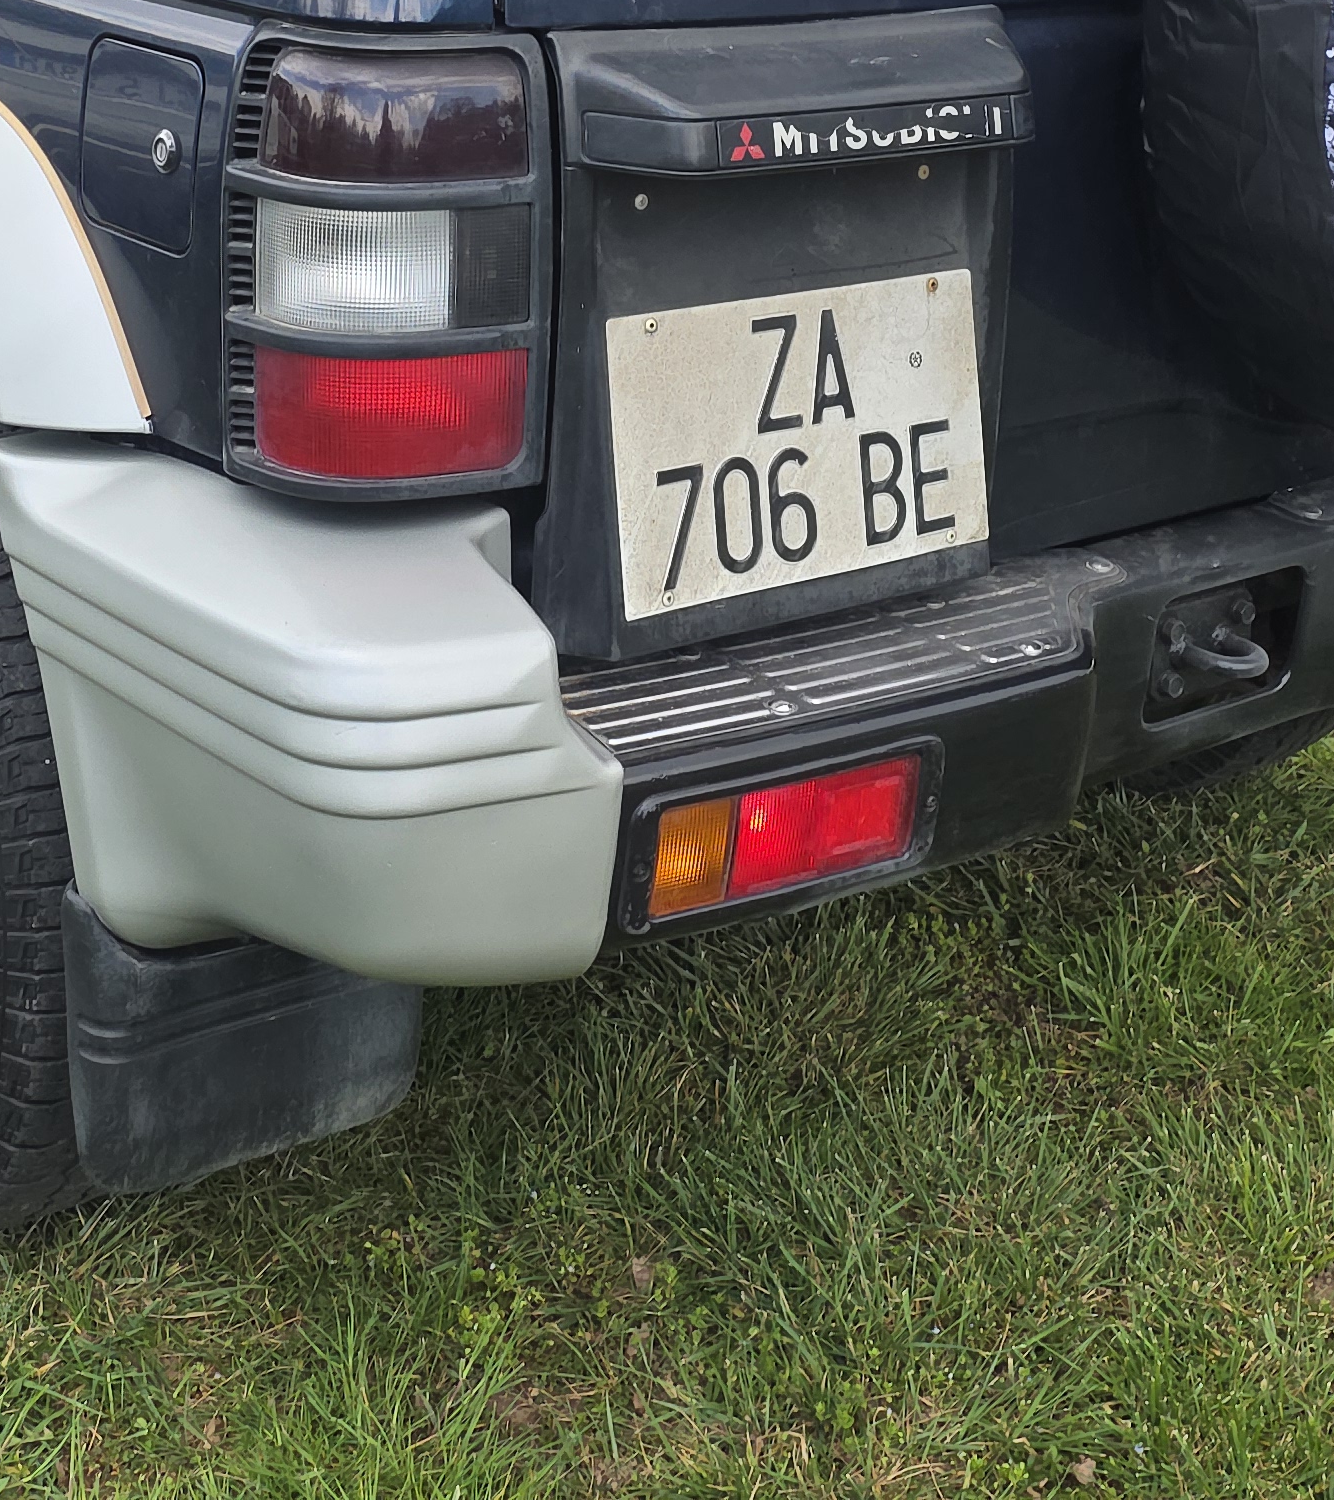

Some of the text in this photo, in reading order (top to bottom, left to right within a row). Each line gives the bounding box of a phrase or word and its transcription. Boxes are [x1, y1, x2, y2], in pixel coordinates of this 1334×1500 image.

[751, 308, 856, 434] ZA
[656, 419, 956, 591] 706 BE
